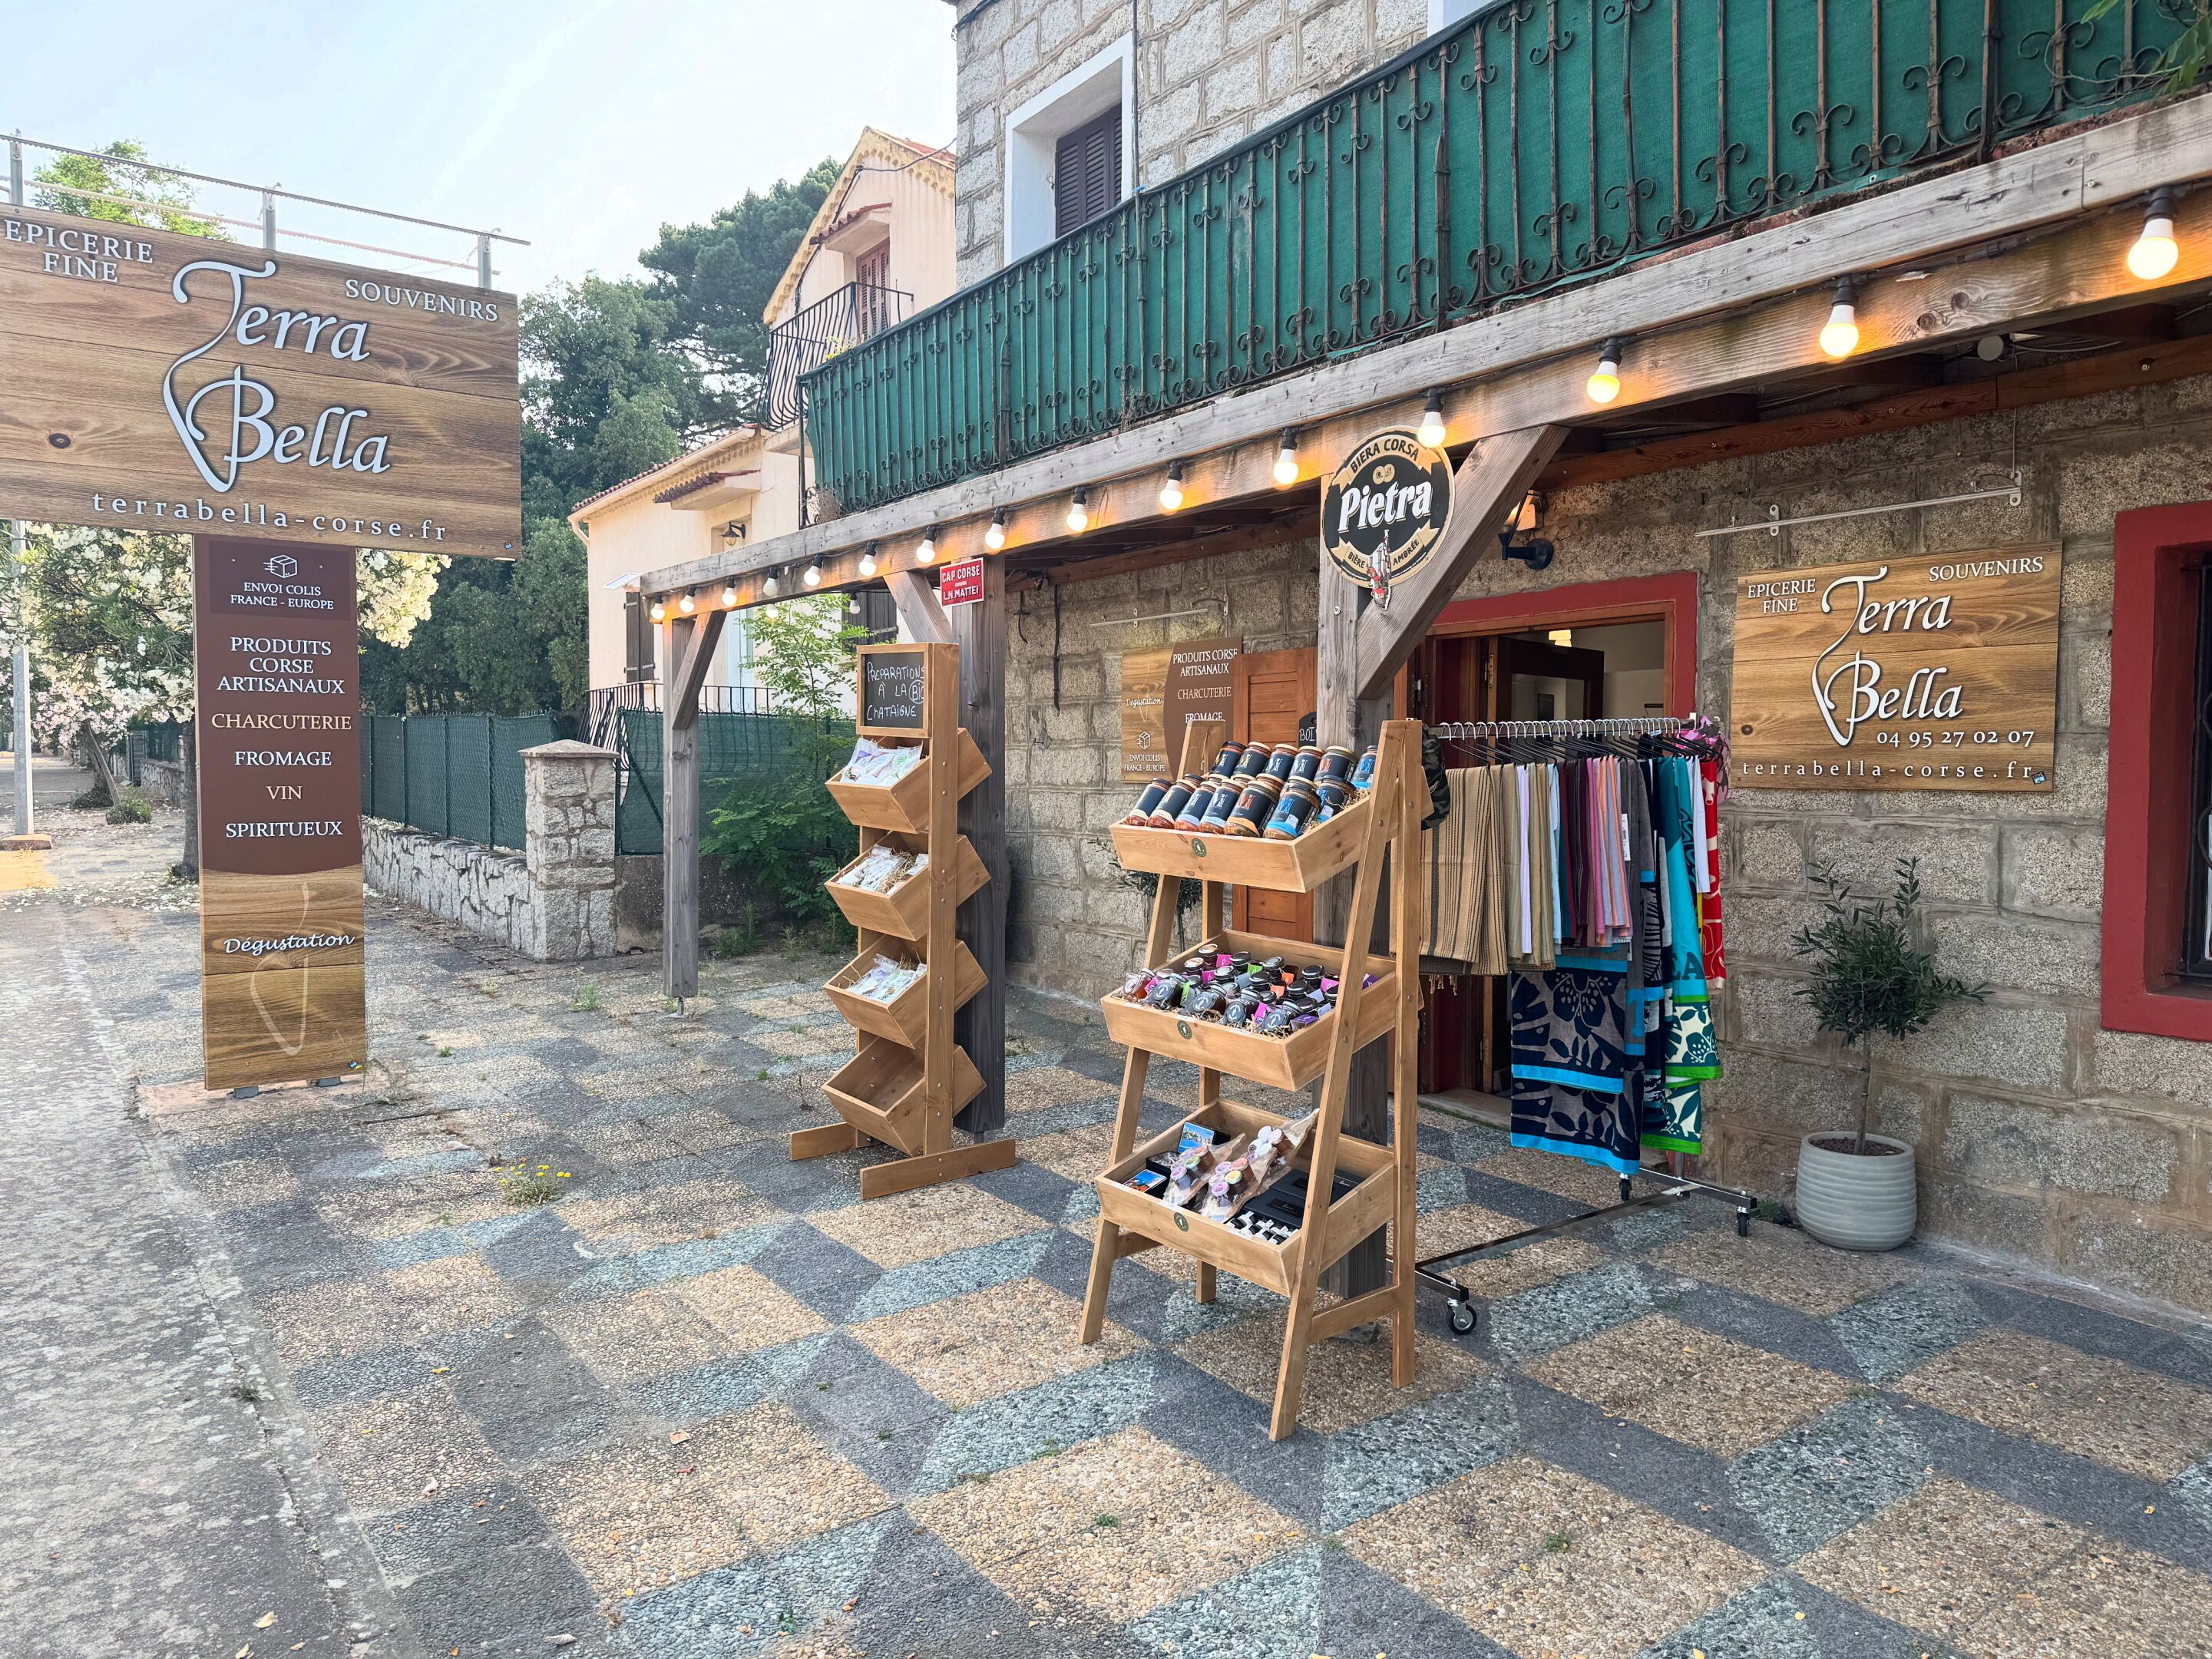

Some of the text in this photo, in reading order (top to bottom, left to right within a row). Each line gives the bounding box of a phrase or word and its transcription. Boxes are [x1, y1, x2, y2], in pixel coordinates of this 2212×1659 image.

[4, 220, 153, 263] EPICERIE
[43, 252, 118, 283] FINE
[346, 279, 498, 322] SOUVENIRS
[163, 261, 371, 388] Terra
[186, 365, 391, 474] Bella
[1350, 438, 1420, 474] BIERA CORSA
[92, 493, 445, 540] terrabella-corse.fr
[1337, 481, 1433, 534] Pietra
[1393, 538, 1420, 566] AMBRÉE
[942, 565, 980, 583] CAP CORSE
[1929, 556, 2044, 582] SOUVENIRS
[244, 582, 321, 596] ENVOI COLIS
[1747, 579, 1817, 599] EPICERIE
[230, 594, 278, 606] FRANCE
[288, 598, 334, 610] EUROPE
[1762, 598, 1798, 614] FINE
[1813, 565, 1953, 670] Terra
[230, 636, 331, 656] PRODUITS
[250, 657, 313, 674] CORSE
[1173, 650, 1211, 664] PRODUITS
[1179, 663, 1229, 677] ARTISANAUX
[217, 676, 345, 694] ARTISANAUX
[894, 683, 907, 696] LA
[1177, 686, 1232, 699] CHARCUTERIE
[1823, 649, 1963, 722] Bella
[211, 713, 351, 730] CHARCUTERIE
[1876, 731, 2035, 749] 04 95 27 02 07
[234, 751, 332, 766] FROMAGE
[1743, 760, 2032, 778] terrabella-corse.fr
[266, 786, 303, 800] VIN
[226, 821, 342, 838] SPIRITUEUX
[223, 933, 355, 956] Dégustation
